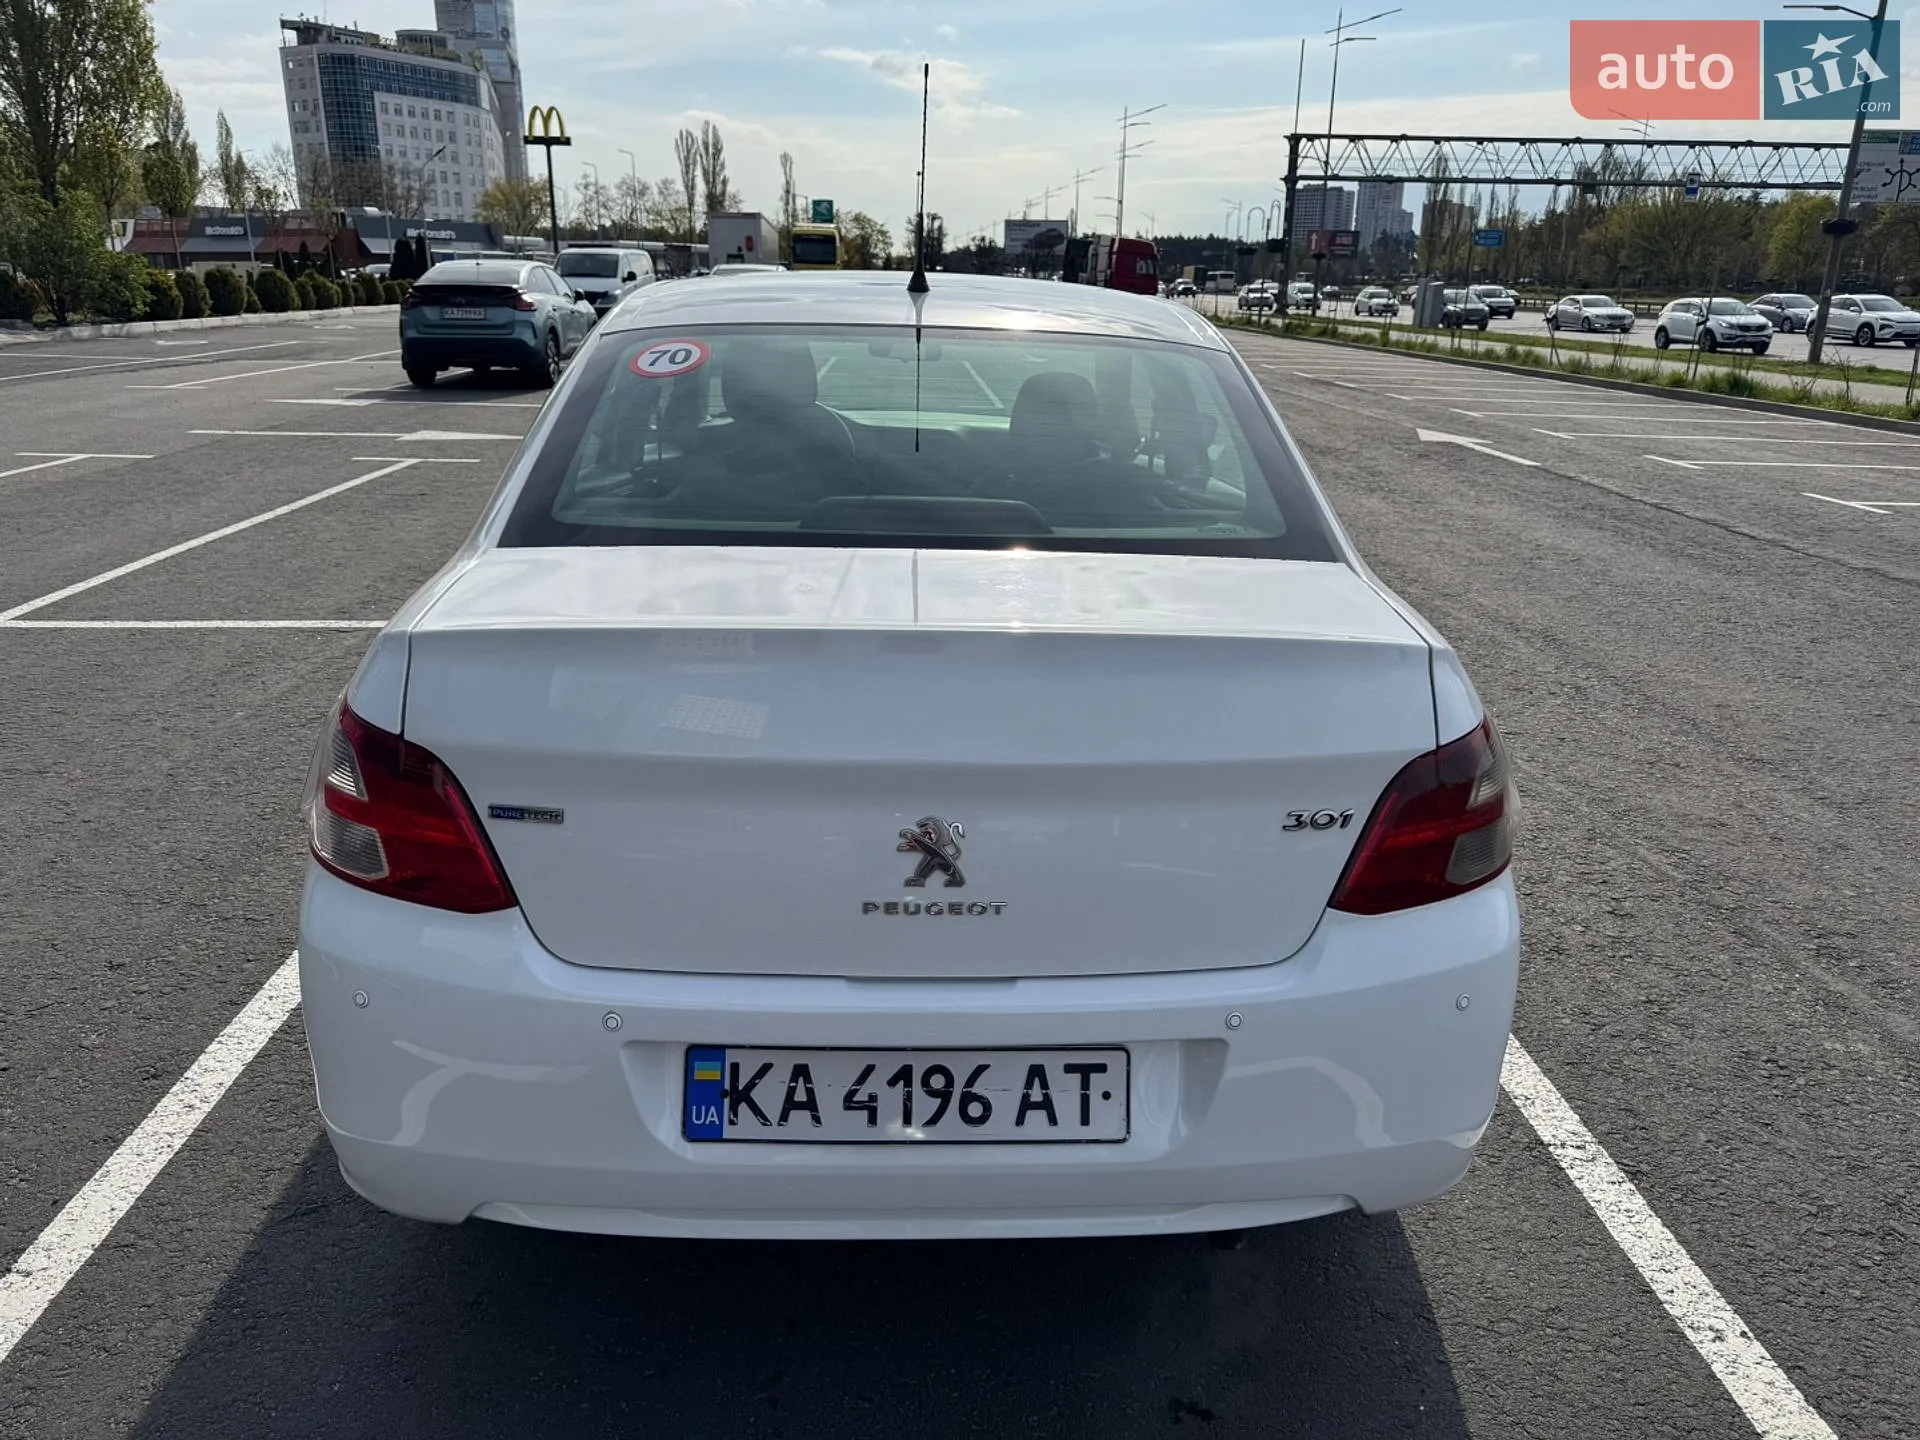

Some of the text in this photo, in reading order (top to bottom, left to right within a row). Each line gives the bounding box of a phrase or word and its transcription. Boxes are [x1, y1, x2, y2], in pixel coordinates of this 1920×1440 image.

[648, 348, 692, 367] 70
[1282, 808, 1354, 831] 301
[862, 902, 1008, 915] PEUGEOT
[728, 1062, 1108, 1127] KA 4196 AT
[692, 1105, 719, 1125] UA
